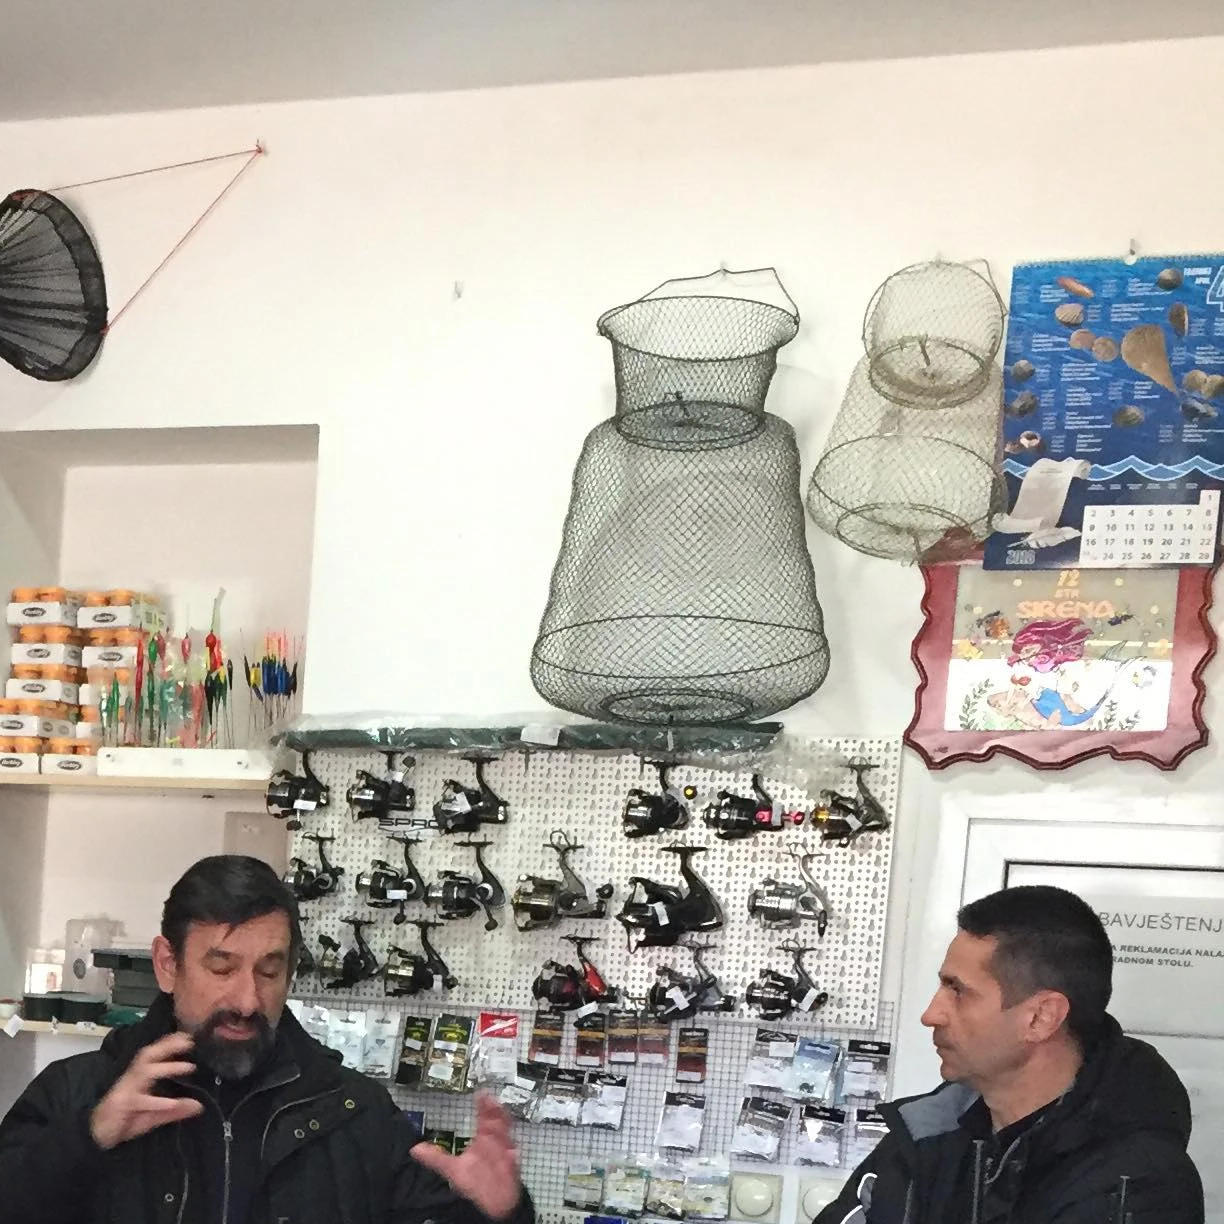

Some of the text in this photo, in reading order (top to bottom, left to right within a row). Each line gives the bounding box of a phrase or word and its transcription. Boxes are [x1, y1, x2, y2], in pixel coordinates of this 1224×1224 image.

[1098, 912, 1223, 933] BAVJEŠTENJ
[1120, 945, 1192, 956] REKLAMACIJA
[1196, 949, 1224, 958] NALA
[1158, 959, 1194, 968] STOLU.
